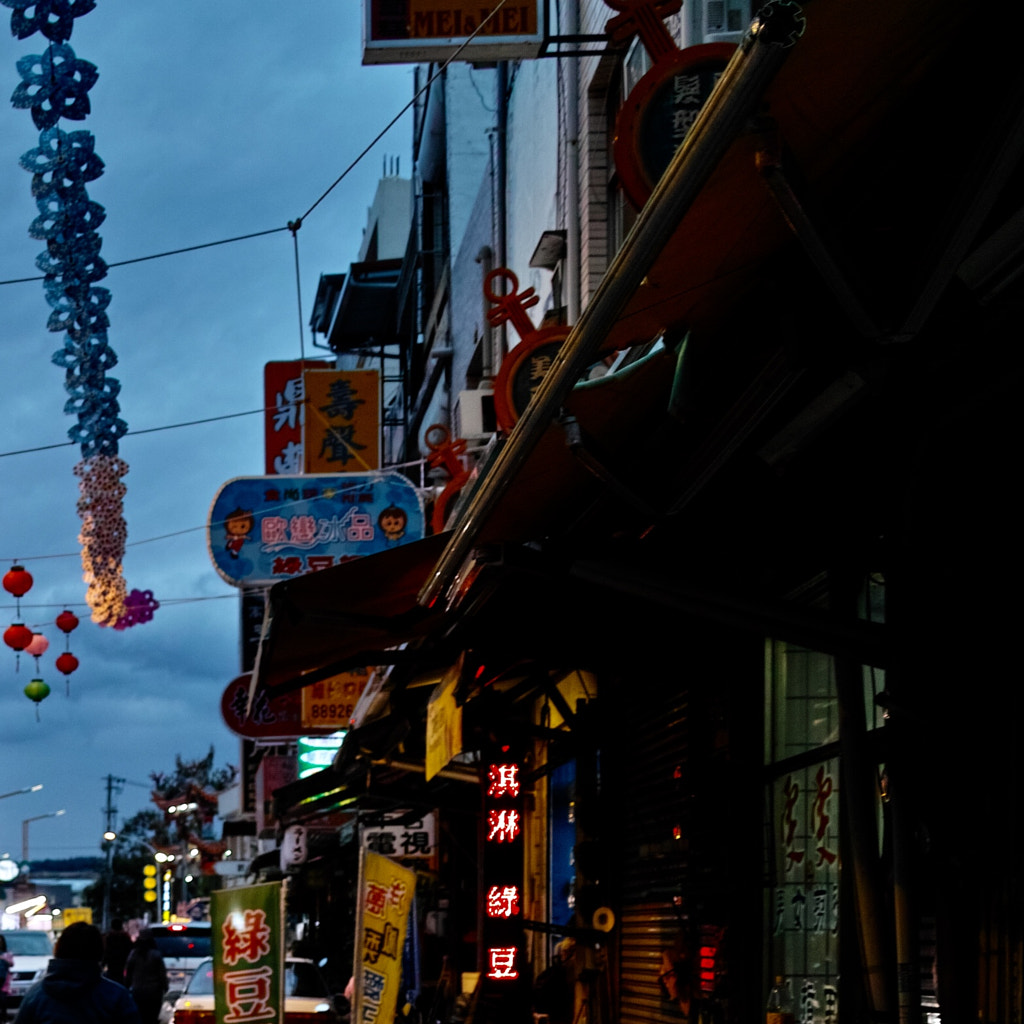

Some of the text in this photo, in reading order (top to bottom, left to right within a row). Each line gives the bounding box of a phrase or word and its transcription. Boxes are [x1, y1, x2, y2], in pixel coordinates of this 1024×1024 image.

[413, 6, 529, 38] MEI&MEI
[366, 831, 432, 855] 電視
[487, 762, 520, 980] 淇淋 綠豆
